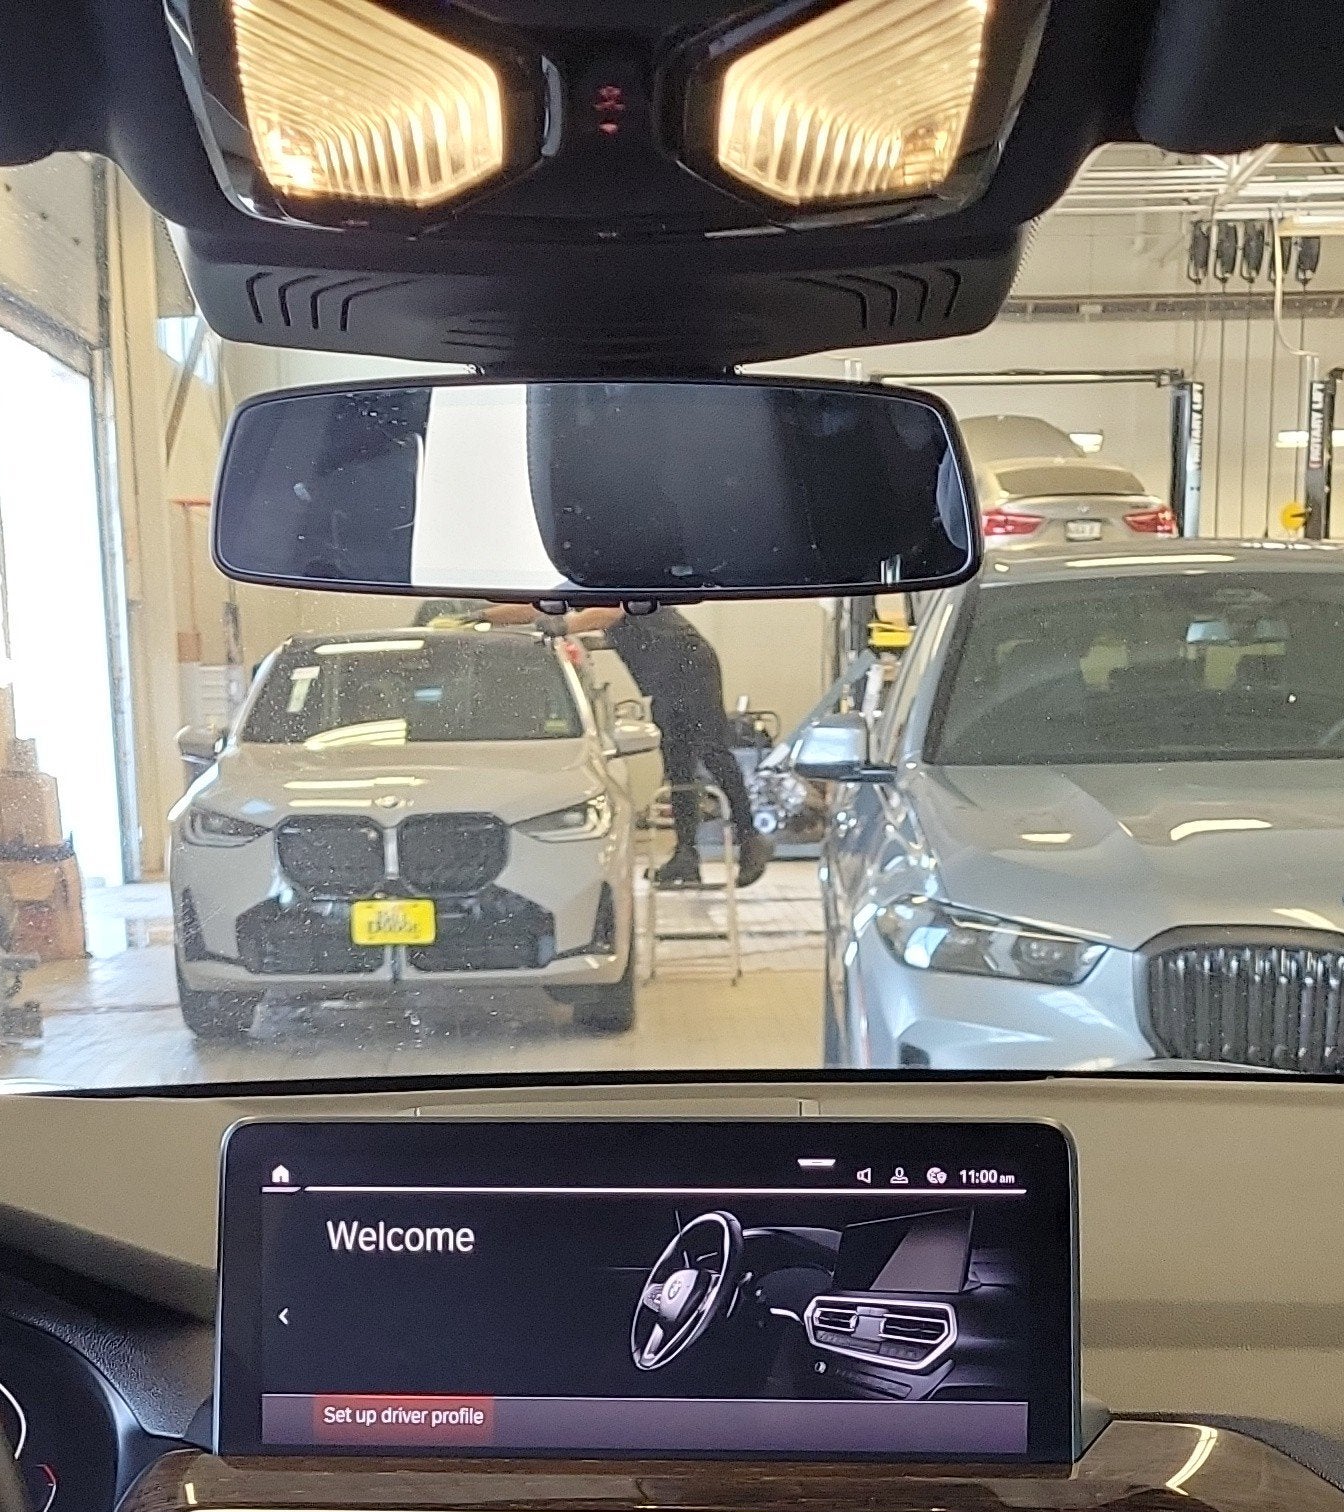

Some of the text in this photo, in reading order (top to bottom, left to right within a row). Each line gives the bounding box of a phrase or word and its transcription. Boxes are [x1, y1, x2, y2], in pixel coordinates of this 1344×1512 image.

[1311, 382, 1325, 410] LIFT
[959, 1169, 1016, 1184] 11:00 am
[325, 1219, 475, 1252] Welcome
[323, 1406, 484, 1428] Set up driver profile
